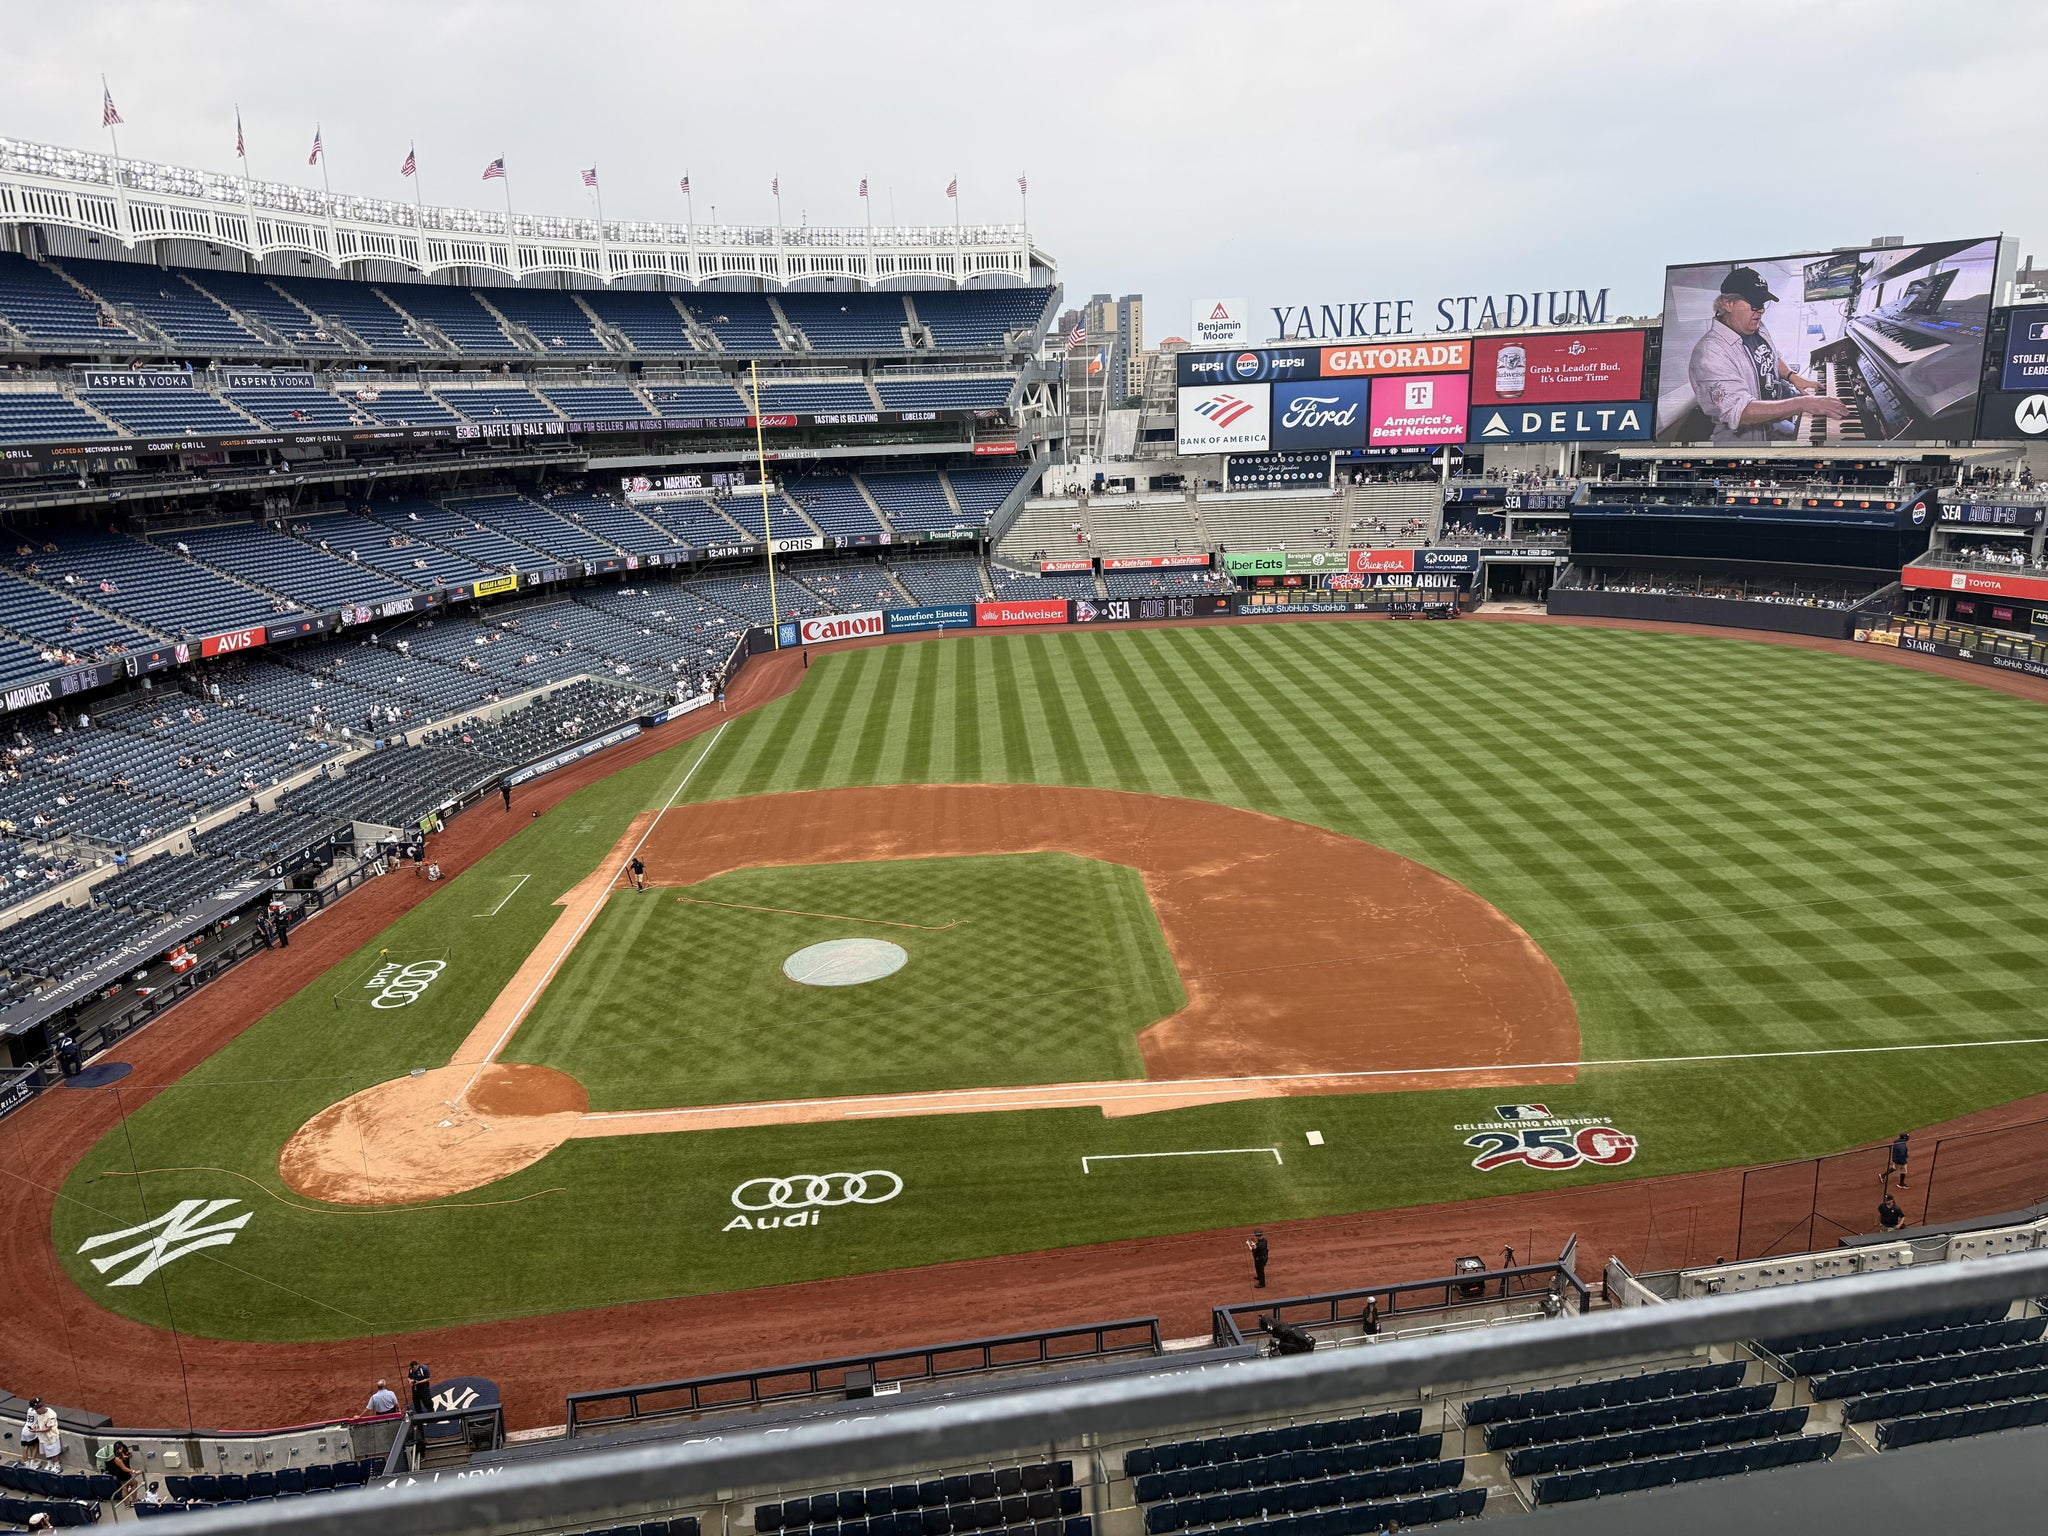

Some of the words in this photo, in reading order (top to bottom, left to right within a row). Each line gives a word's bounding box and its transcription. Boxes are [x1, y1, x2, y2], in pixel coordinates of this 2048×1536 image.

[1270, 300, 1413, 340] YANKEE
[1436, 288, 1610, 331] STADIUM
[1197, 320, 1241, 333] Benjamin
[1203, 331, 1234, 341] Moore
[1272, 358, 1305, 368] PEPSI
[1329, 345, 1463, 371] GATORADE
[2012, 354, 2046, 364] STOLEN
[1192, 362, 1224, 372] PEPSI
[1238, 361, 1258, 369] PEPSI
[1530, 365, 1552, 374] Grab
[1562, 363, 1598, 373] Leadoff
[94, 375, 134, 386] ASPEN
[149, 376, 187, 386] VODKA
[234, 377, 267, 386] ASPEN
[279, 377, 310, 386] VODKA
[1541, 375, 1555, 383] It's
[1557, 374, 1583, 382] Game
[1585, 373, 1609, 382] Time
[902, 412, 936, 421] LOBELS.COM
[1282, 396, 1358, 429] Ford
[566, 423, 582, 433] LOOK
[583, 422, 595, 432] FOR
[596, 421, 624, 431] SELLERS
[625, 421, 639, 431] AND
[640, 420, 662, 430] KIOSKS
[663, 419, 704, 429] THROUGHOUT
[705, 418, 718, 428] THE
[718, 417, 746, 427] STADIUM
[814, 415, 840, 425] TASTING
[840, 415, 847, 424] IS
[847, 414, 879, 423] BELIEVING
[1384, 414, 1452, 428] America's
[1522, 409, 1641, 434] DELTA
[482, 424, 510, 438] RAFFLE
[512, 423, 522, 436] ON
[523, 423, 544, 436] SALE
[545, 422, 564, 434] NOW
[1373, 425, 1403, 438] Best
[1405, 424, 1464, 437] Network
[295, 435, 317, 443] COLONY
[322, 434, 342, 442] GRILL
[1180, 437, 1207, 446] BANK
[1209, 436, 1221, 444] OF
[1223, 434, 1267, 444] AMERICA
[84, 446, 111, 454] SECTIONS
[148, 443, 174, 451] COLONY
[181, 441, 206, 450] GRILL
[6, 450, 33, 459] GRILL
[663, 475, 702, 490] MARINERS
[1505, 496, 1521, 509] SEA
[1527, 496, 1545, 509] AUG
[1941, 505, 1961, 520] SEA
[1969, 506, 1991, 522] AUG
[1993, 507, 2017, 523] 11-13
[929, 531, 951, 540] Poland
[952, 530, 974, 541] Spring
[779, 539, 813, 551] ORIS
[708, 548, 727, 558] 12:41
[727, 547, 739, 556] PM
[1438, 554, 1468, 563] coupa
[1121, 559, 1137, 567] State
[1170, 557, 1186, 565] State
[1255, 559, 1283, 569] Eats
[530, 572, 541, 585] SEA
[1329, 573, 1363, 583] Jersey
[1375, 574, 1384, 587] A
[1387, 574, 1413, 588] SUB
[1968, 579, 2002, 590] TOYOTA
[382, 598, 414, 617] MARINERS
[1108, 602, 1130, 619] SEA
[1140, 600, 1165, 618] AUG
[1168, 599, 1194, 616] 11-13
[1241, 605, 1274, 615] StubHub
[1276, 604, 1309, 613] StubHub
[1312, 603, 1346, 612] StubHub
[891, 612, 935, 623] Montefiore
[935, 609, 968, 619] Einstein
[802, 615, 882, 641] Canon
[217, 631, 252, 653] AVIS
[1906, 639, 1936, 653] STARR
[1959, 649, 1971, 658] 385
[1993, 656, 2023, 669] StubHub
[5, 681, 52, 711] MARINERS
[61, 674, 79, 694] AUG
[79, 668, 99, 690] 11-13
[364, 962, 403, 989] Audi
[1454, 1120, 1540, 1131] CELEBRATING
[1543, 1116, 1613, 1127] AMERICA'S
[722, 1210, 820, 1232] Audi
